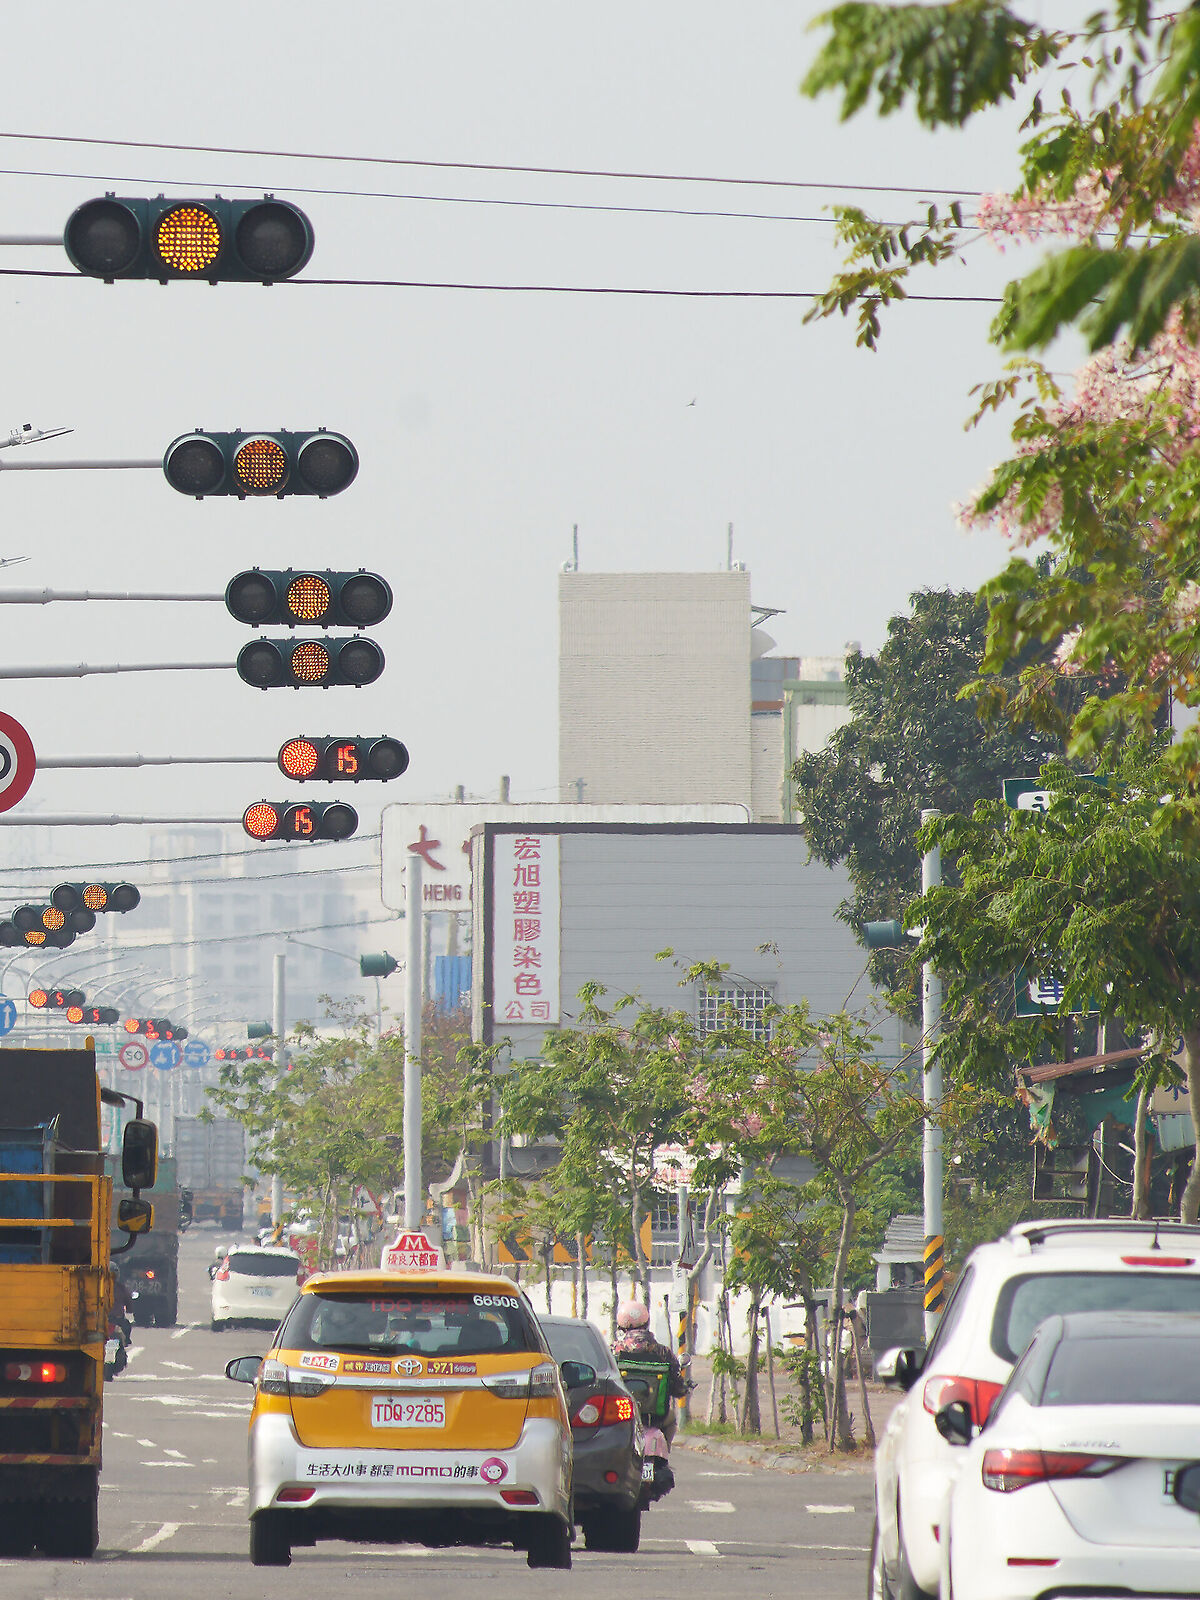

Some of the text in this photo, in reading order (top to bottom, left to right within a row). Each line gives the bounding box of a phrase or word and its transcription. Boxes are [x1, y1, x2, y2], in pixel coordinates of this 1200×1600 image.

[337, 745, 358, 774] 15
[295, 808, 313, 834] 15
[505, 1000, 550, 1021] 公司
[126, 1050, 143, 1061] 50
[404, 1236, 424, 1250] M
[473, 1295, 519, 1309] 66508
[374, 1403, 445, 1423] TDQ-9285
